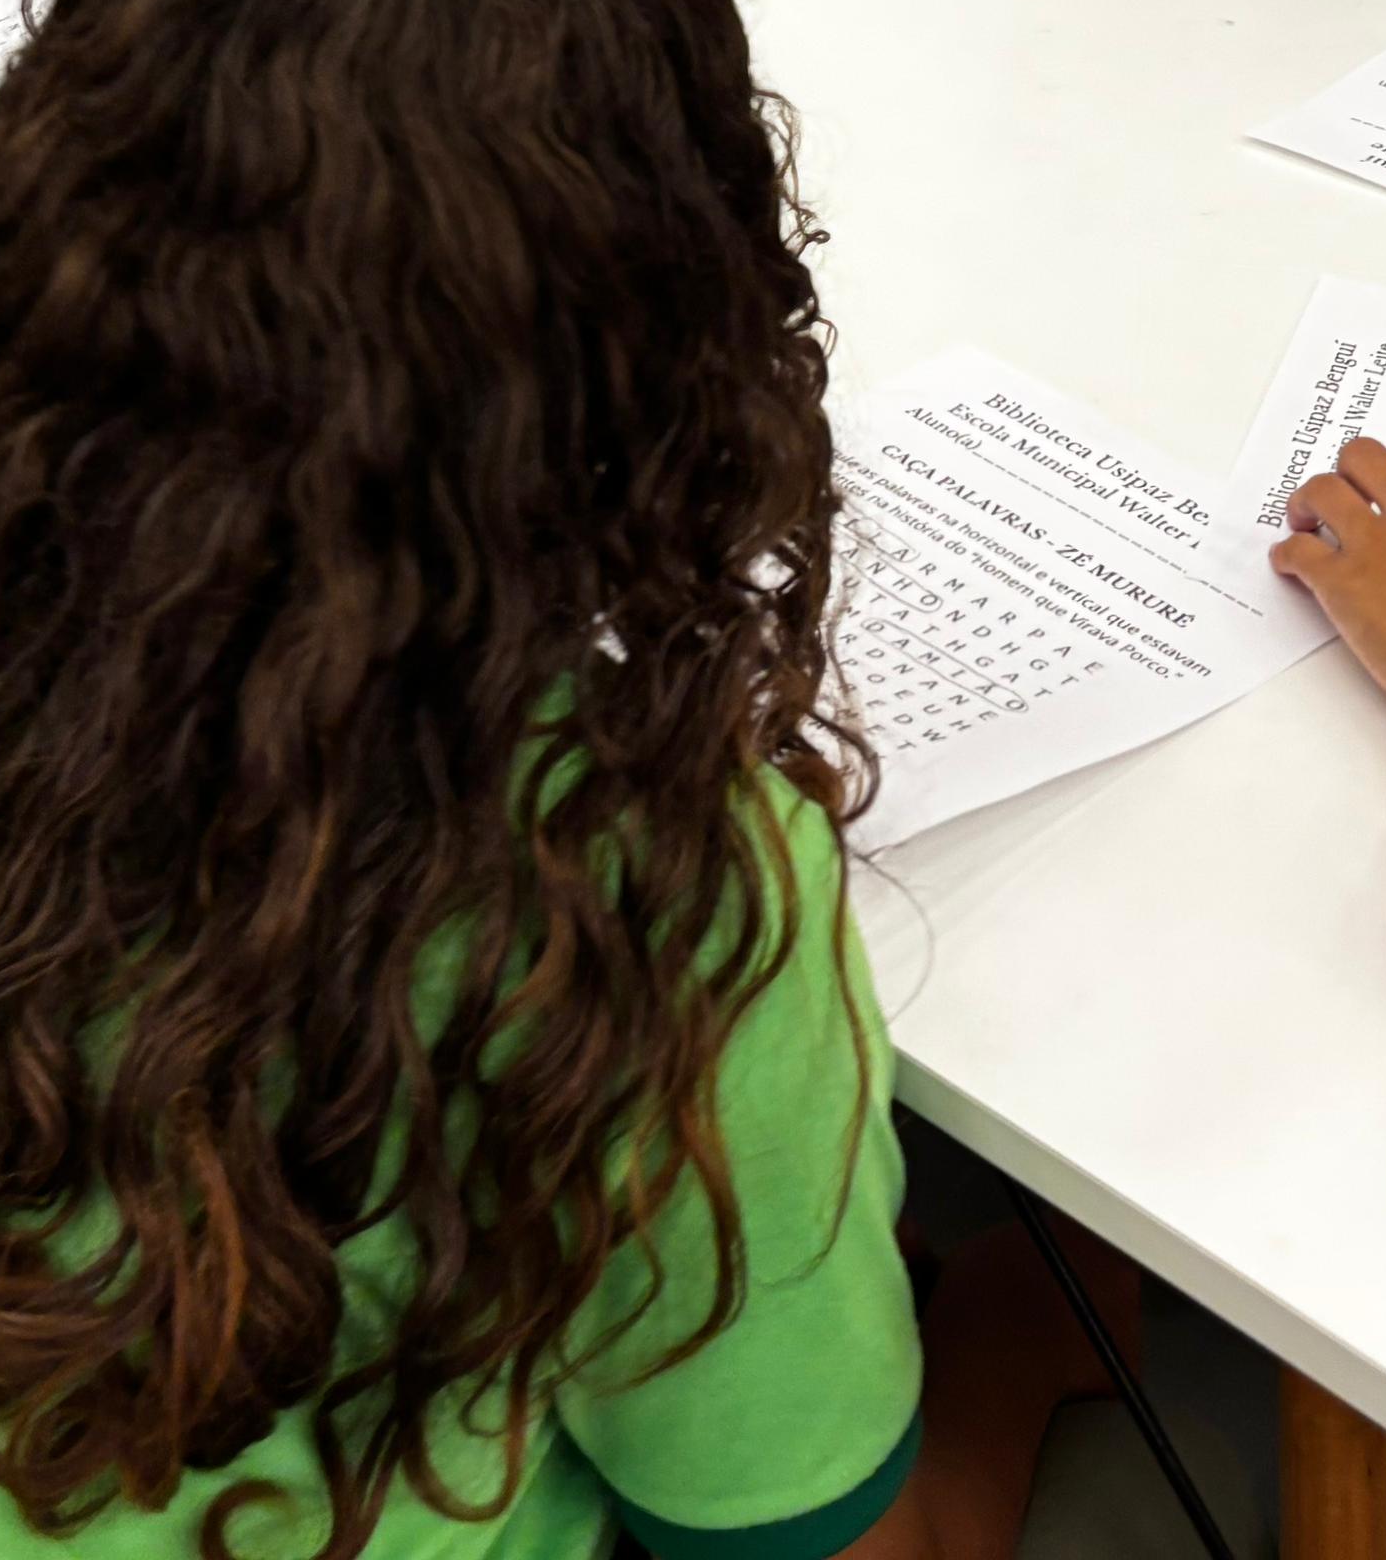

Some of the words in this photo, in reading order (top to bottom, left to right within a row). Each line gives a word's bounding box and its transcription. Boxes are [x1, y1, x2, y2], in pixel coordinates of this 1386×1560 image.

[904, 406, 983, 452] Aluno(a)
[983, 393, 1092, 459] Biblioteca
[1096, 454, 1175, 503] Usipaz
[1257, 448, 1312, 529] Biblioteca
[1292, 395, 1334, 445] Usipaz
[1315, 339, 1357, 394] Bengui
[1344, 377, 1381, 420] Walter
[881, 444, 937, 480] CAÇA
[935, 475, 1047, 541] PALAVRAS
[1056, 544, 1094, 568] ZÉ
[1089, 564, 1196, 629] MURURÉ
[948, 403, 1011, 442] Escola
[1010, 437, 1119, 500] Municipal
[1118, 496, 1192, 542] Walter
[860, 467, 879, 481] as
[874, 478, 938, 516] palavras
[937, 513, 959, 527] na
[958, 522, 1038, 573] horizontal
[1035, 570, 1049, 581] e
[1048, 574, 1110, 616] vertical
[1106, 613, 1140, 636] que
[1140, 632, 1213, 677] estavam
[867, 494, 889, 509] na
[889, 503, 945, 543] história
[944, 538, 968, 557] do
[1035, 595, 1067, 618] que
[1069, 610, 1122, 648] Virava
